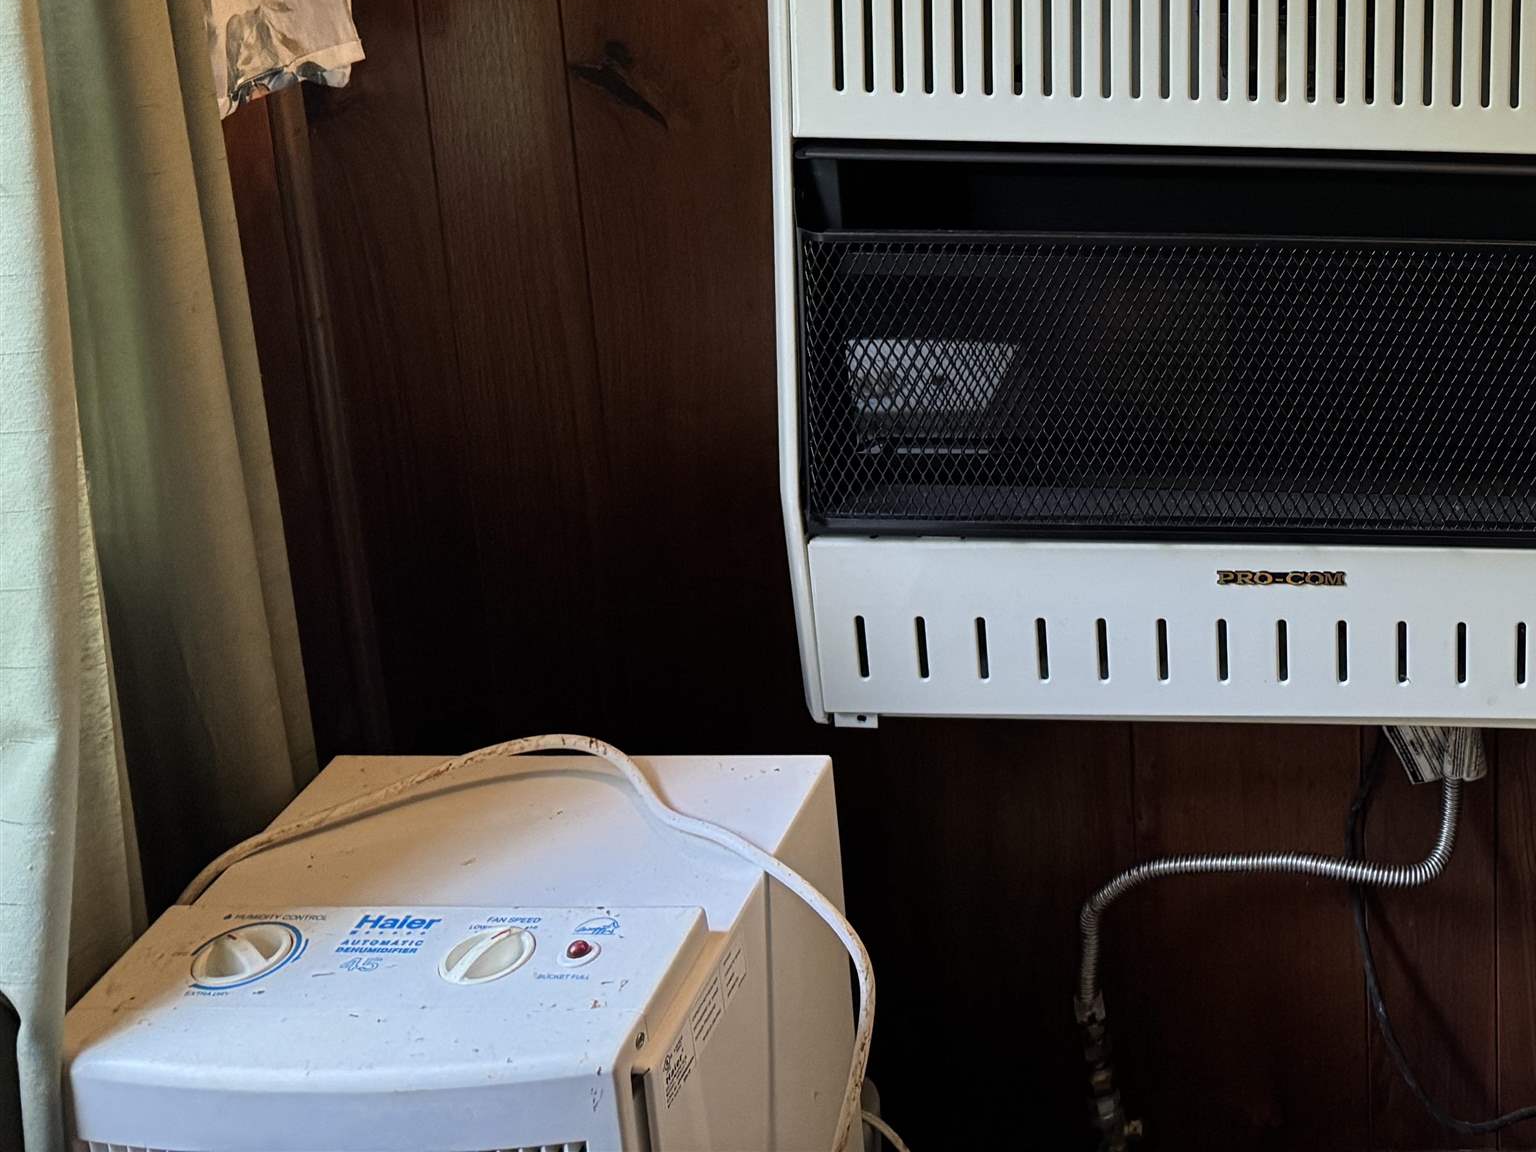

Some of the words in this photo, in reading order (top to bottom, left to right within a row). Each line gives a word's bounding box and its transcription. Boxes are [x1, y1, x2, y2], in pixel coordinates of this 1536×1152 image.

[1217, 570, 1347, 586] PRO-COM
[354, 914, 442, 929] Haier
[487, 916, 508, 924] FAN
[340, 938, 425, 946] AUTOMATIC
[340, 956, 383, 972] 45
